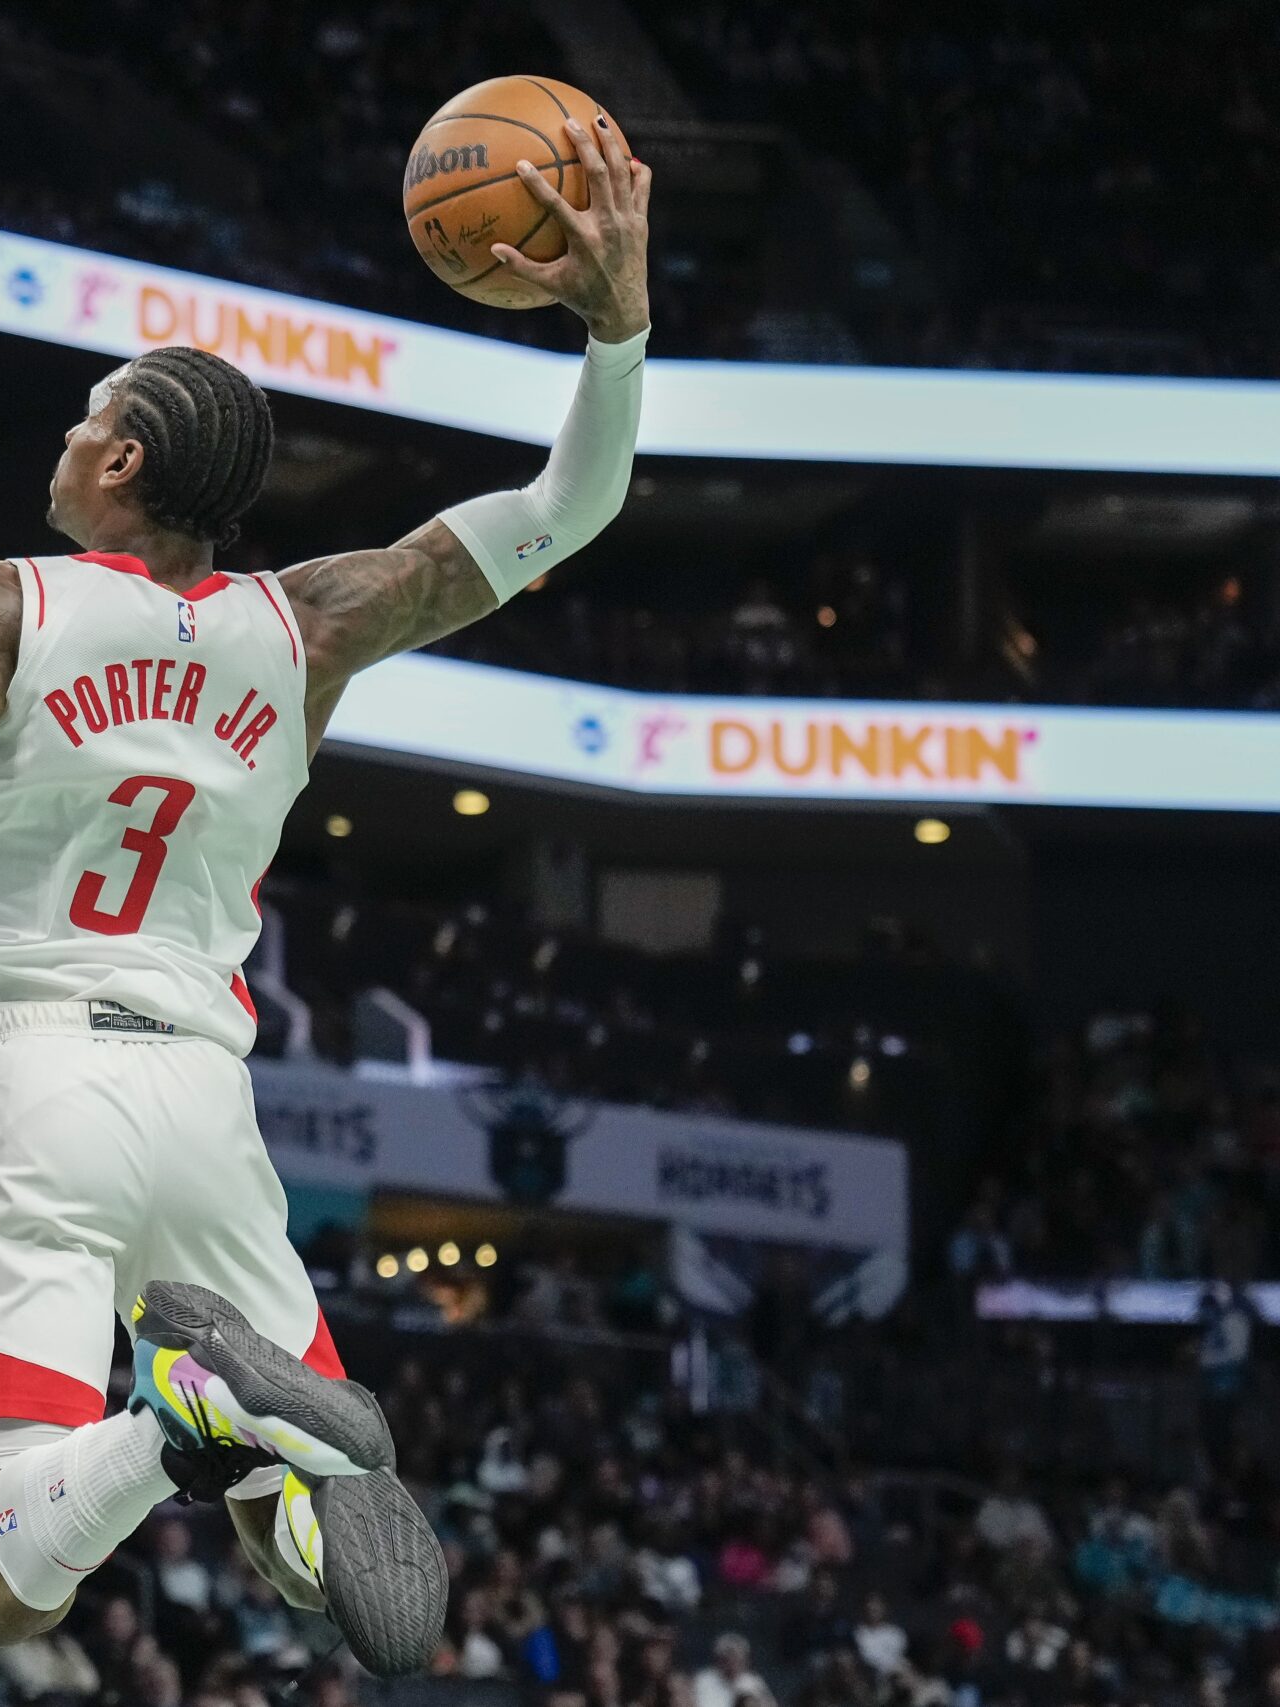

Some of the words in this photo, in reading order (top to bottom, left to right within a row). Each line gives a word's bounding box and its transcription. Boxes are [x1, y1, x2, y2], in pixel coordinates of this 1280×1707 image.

[43, 659, 207, 748] PORTER
[214, 688, 278, 771] JR.
[710, 721, 1038, 782] DUNKIN'
[69, 775, 196, 936] 3
